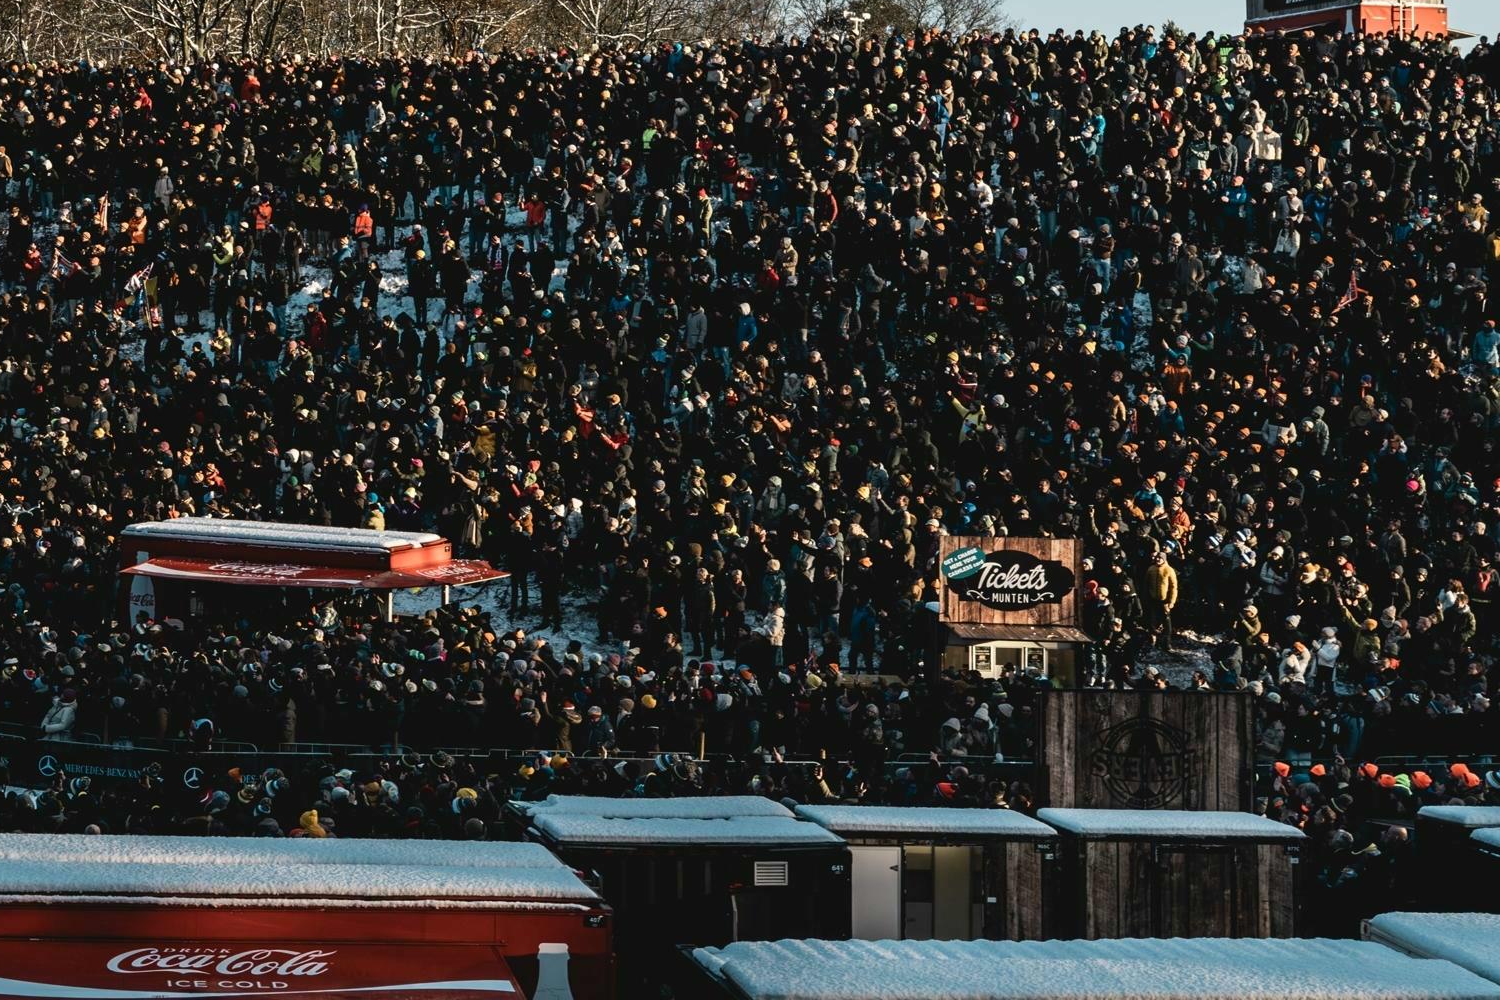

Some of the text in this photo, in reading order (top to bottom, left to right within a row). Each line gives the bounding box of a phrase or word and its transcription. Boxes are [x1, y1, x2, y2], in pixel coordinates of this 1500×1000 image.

[962, 555, 977, 564] YOUR
[977, 562, 1049, 590] Tickets
[991, 592, 1030, 604] MUNTEN
[64, 763, 127, 778] MERCEDES-BENZ
[106, 947, 338, 976] Coca-Cola
[167, 979, 288, 989] ICE COLD
